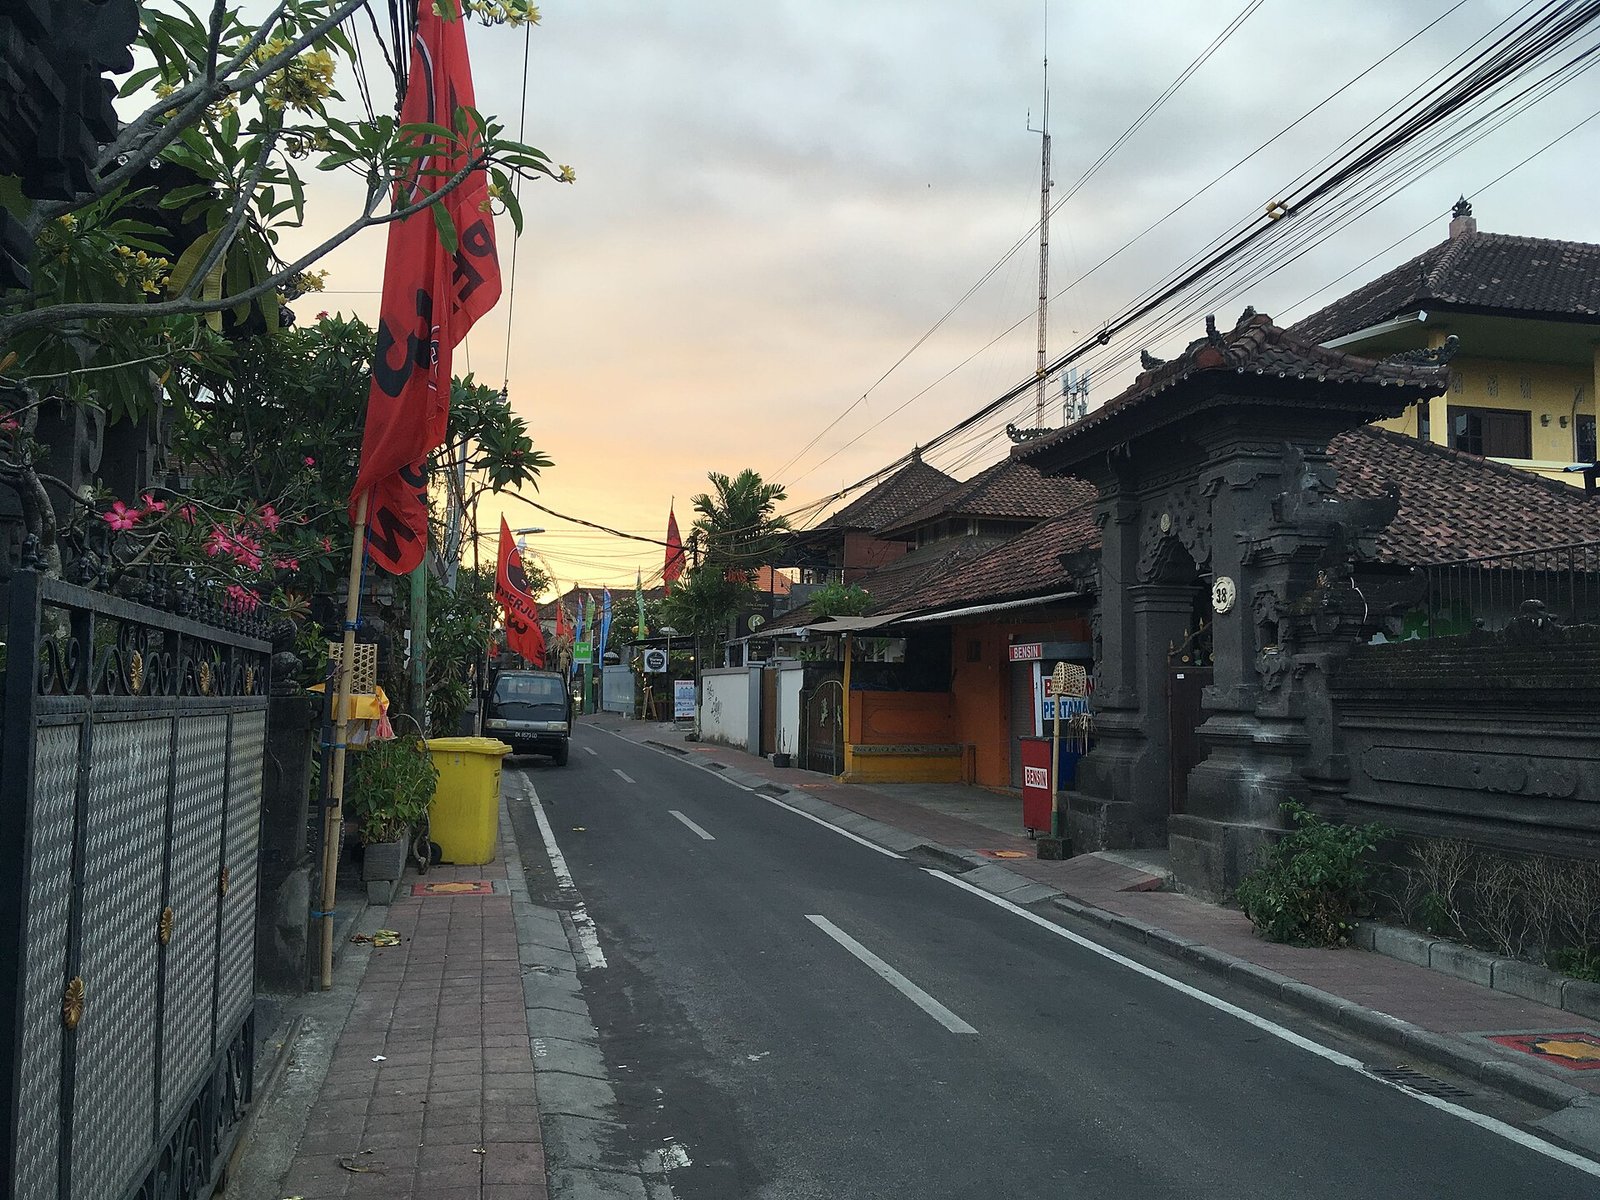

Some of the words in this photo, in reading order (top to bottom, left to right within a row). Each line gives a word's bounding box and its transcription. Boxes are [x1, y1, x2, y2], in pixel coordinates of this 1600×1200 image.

[1216, 587, 1227, 604] 38
[1013, 645, 1039, 659] BENSIN
[1026, 768, 1047, 787] BENSIN
